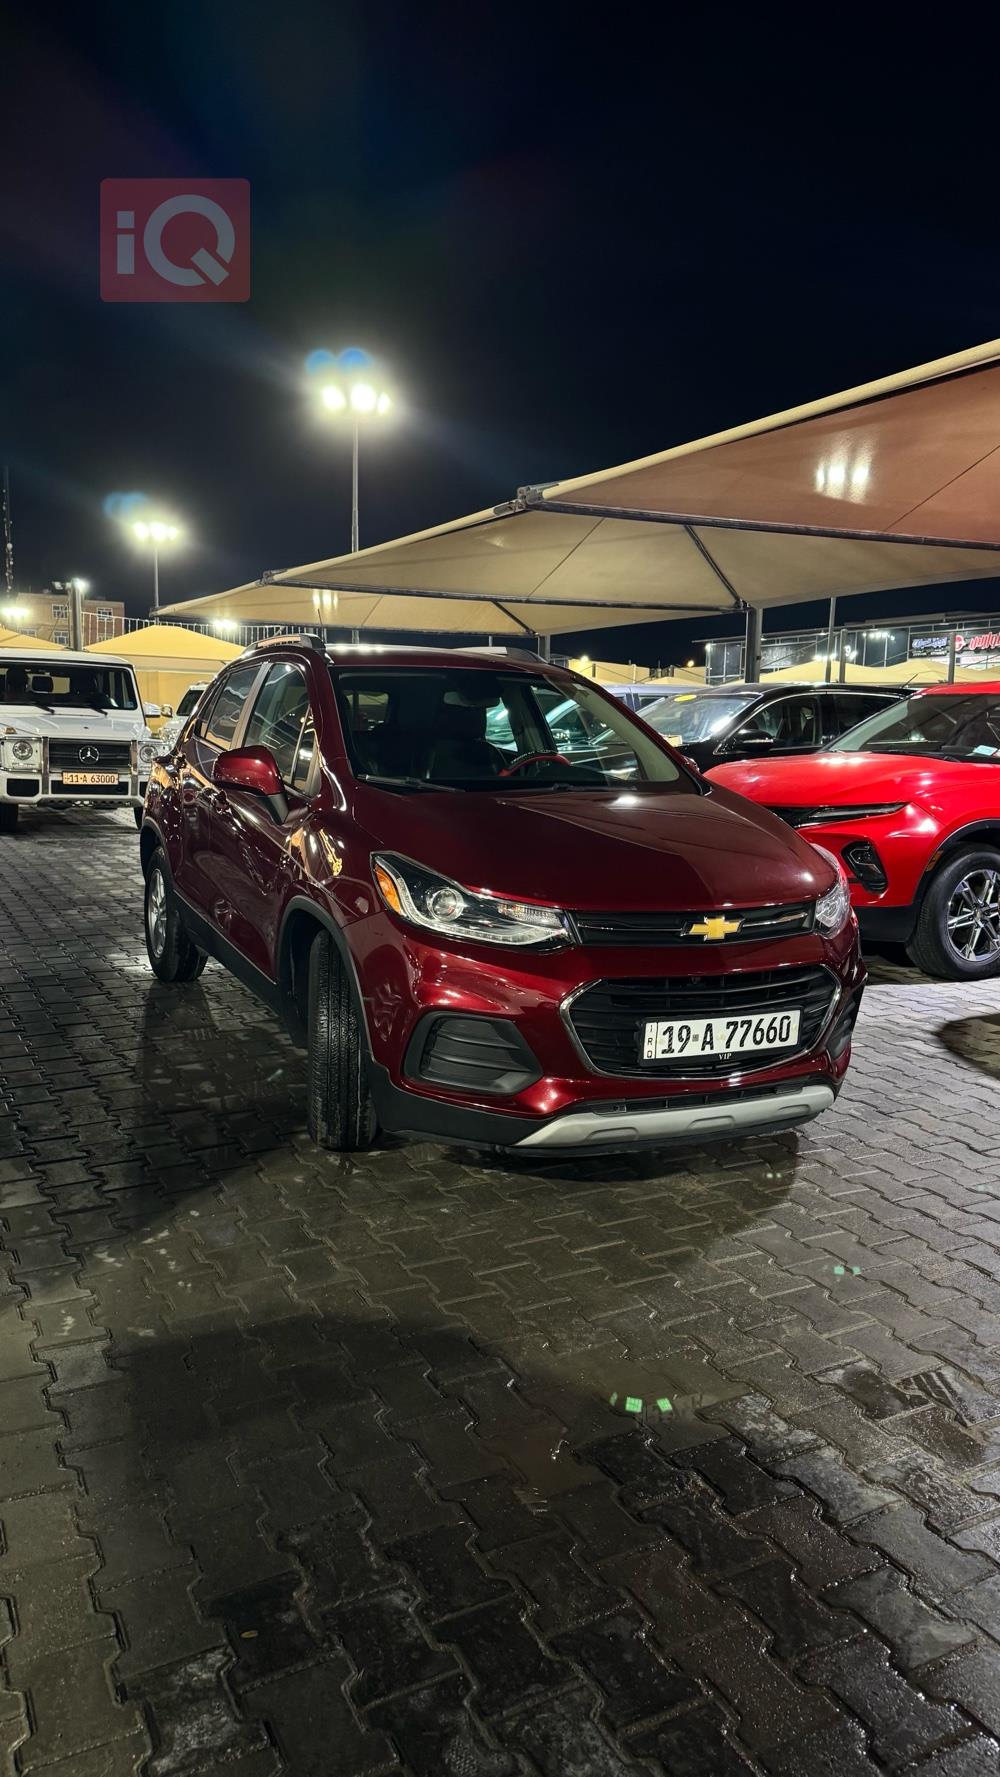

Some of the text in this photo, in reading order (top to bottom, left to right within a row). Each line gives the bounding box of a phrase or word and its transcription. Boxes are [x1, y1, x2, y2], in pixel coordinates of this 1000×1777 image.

[90, 774, 116, 784] 63000
[661, 1015, 791, 1055] 19 A 77660
[718, 1052, 732, 1061] VIP
